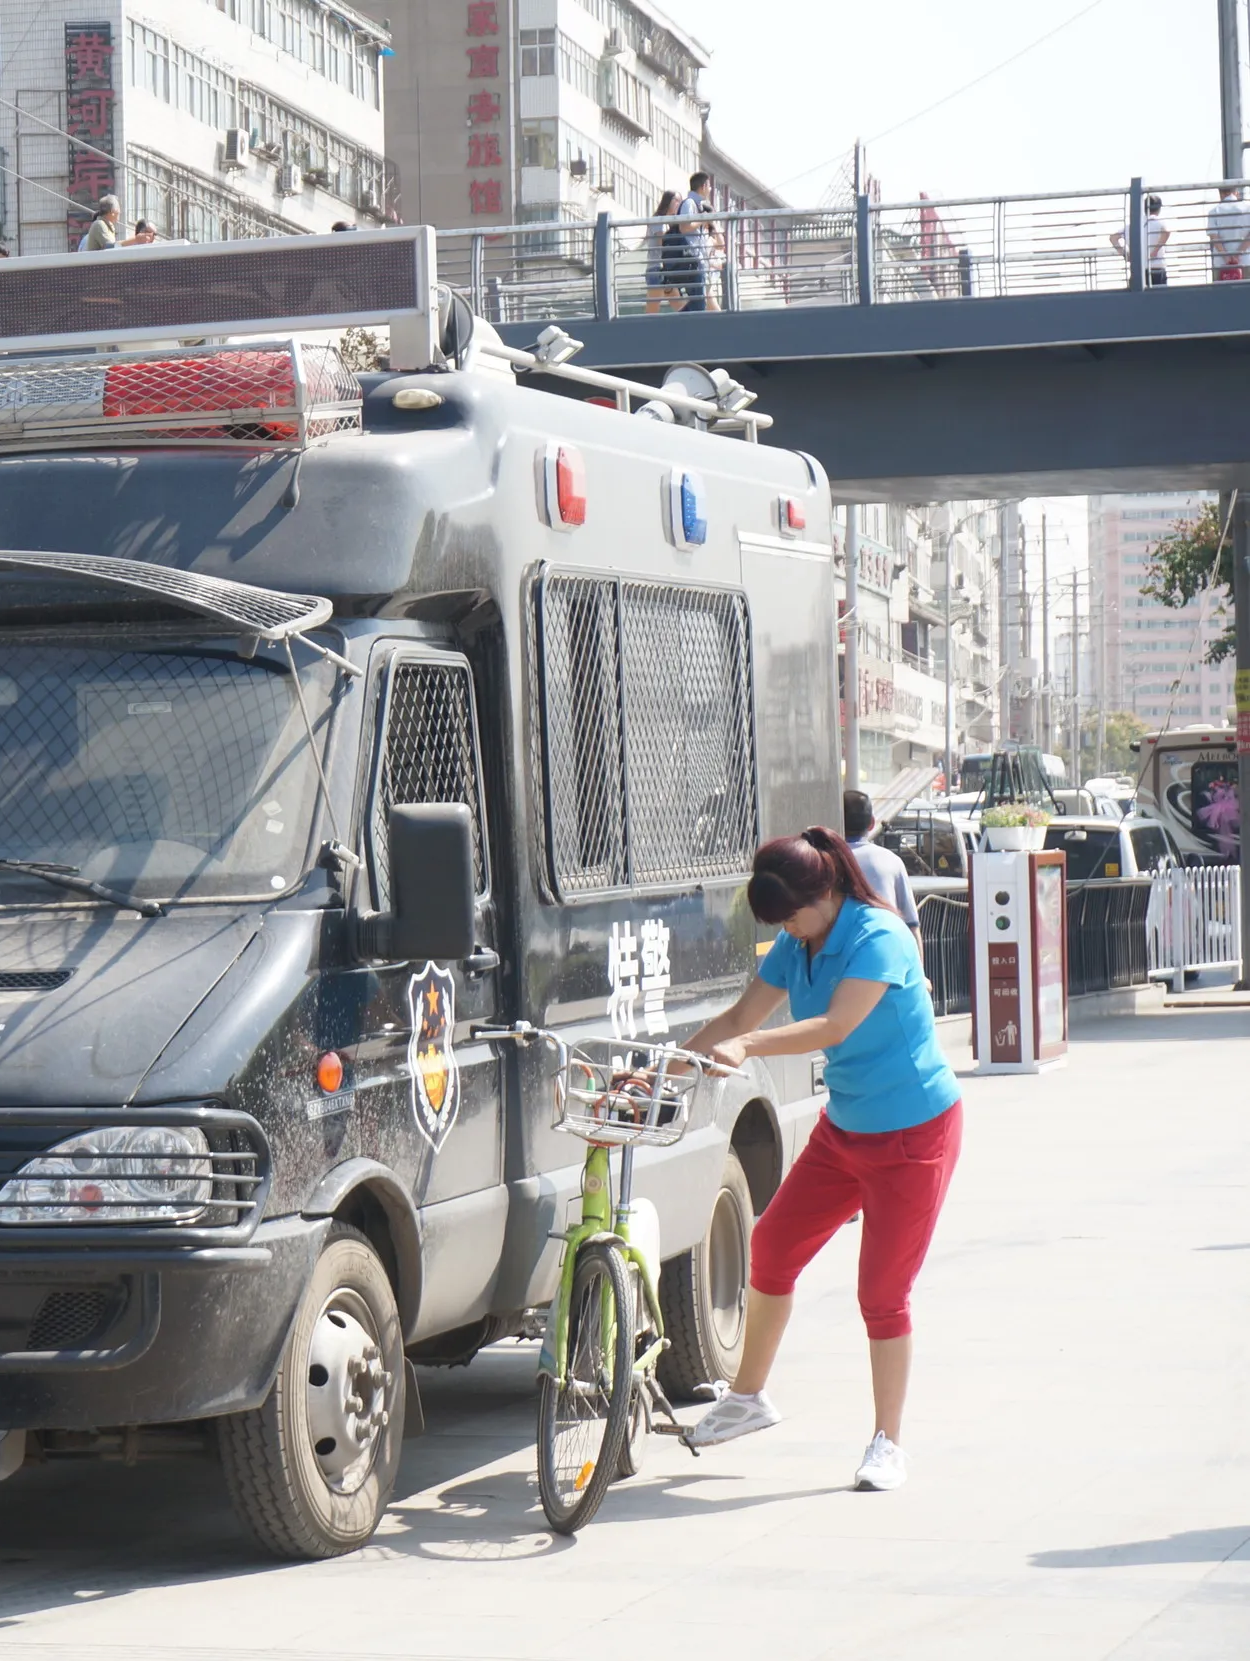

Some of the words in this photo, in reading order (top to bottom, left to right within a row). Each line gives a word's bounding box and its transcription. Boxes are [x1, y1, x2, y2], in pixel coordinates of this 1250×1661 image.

[607, 918, 671, 1040] 特警
[993, 988, 1018, 997] 可回收
